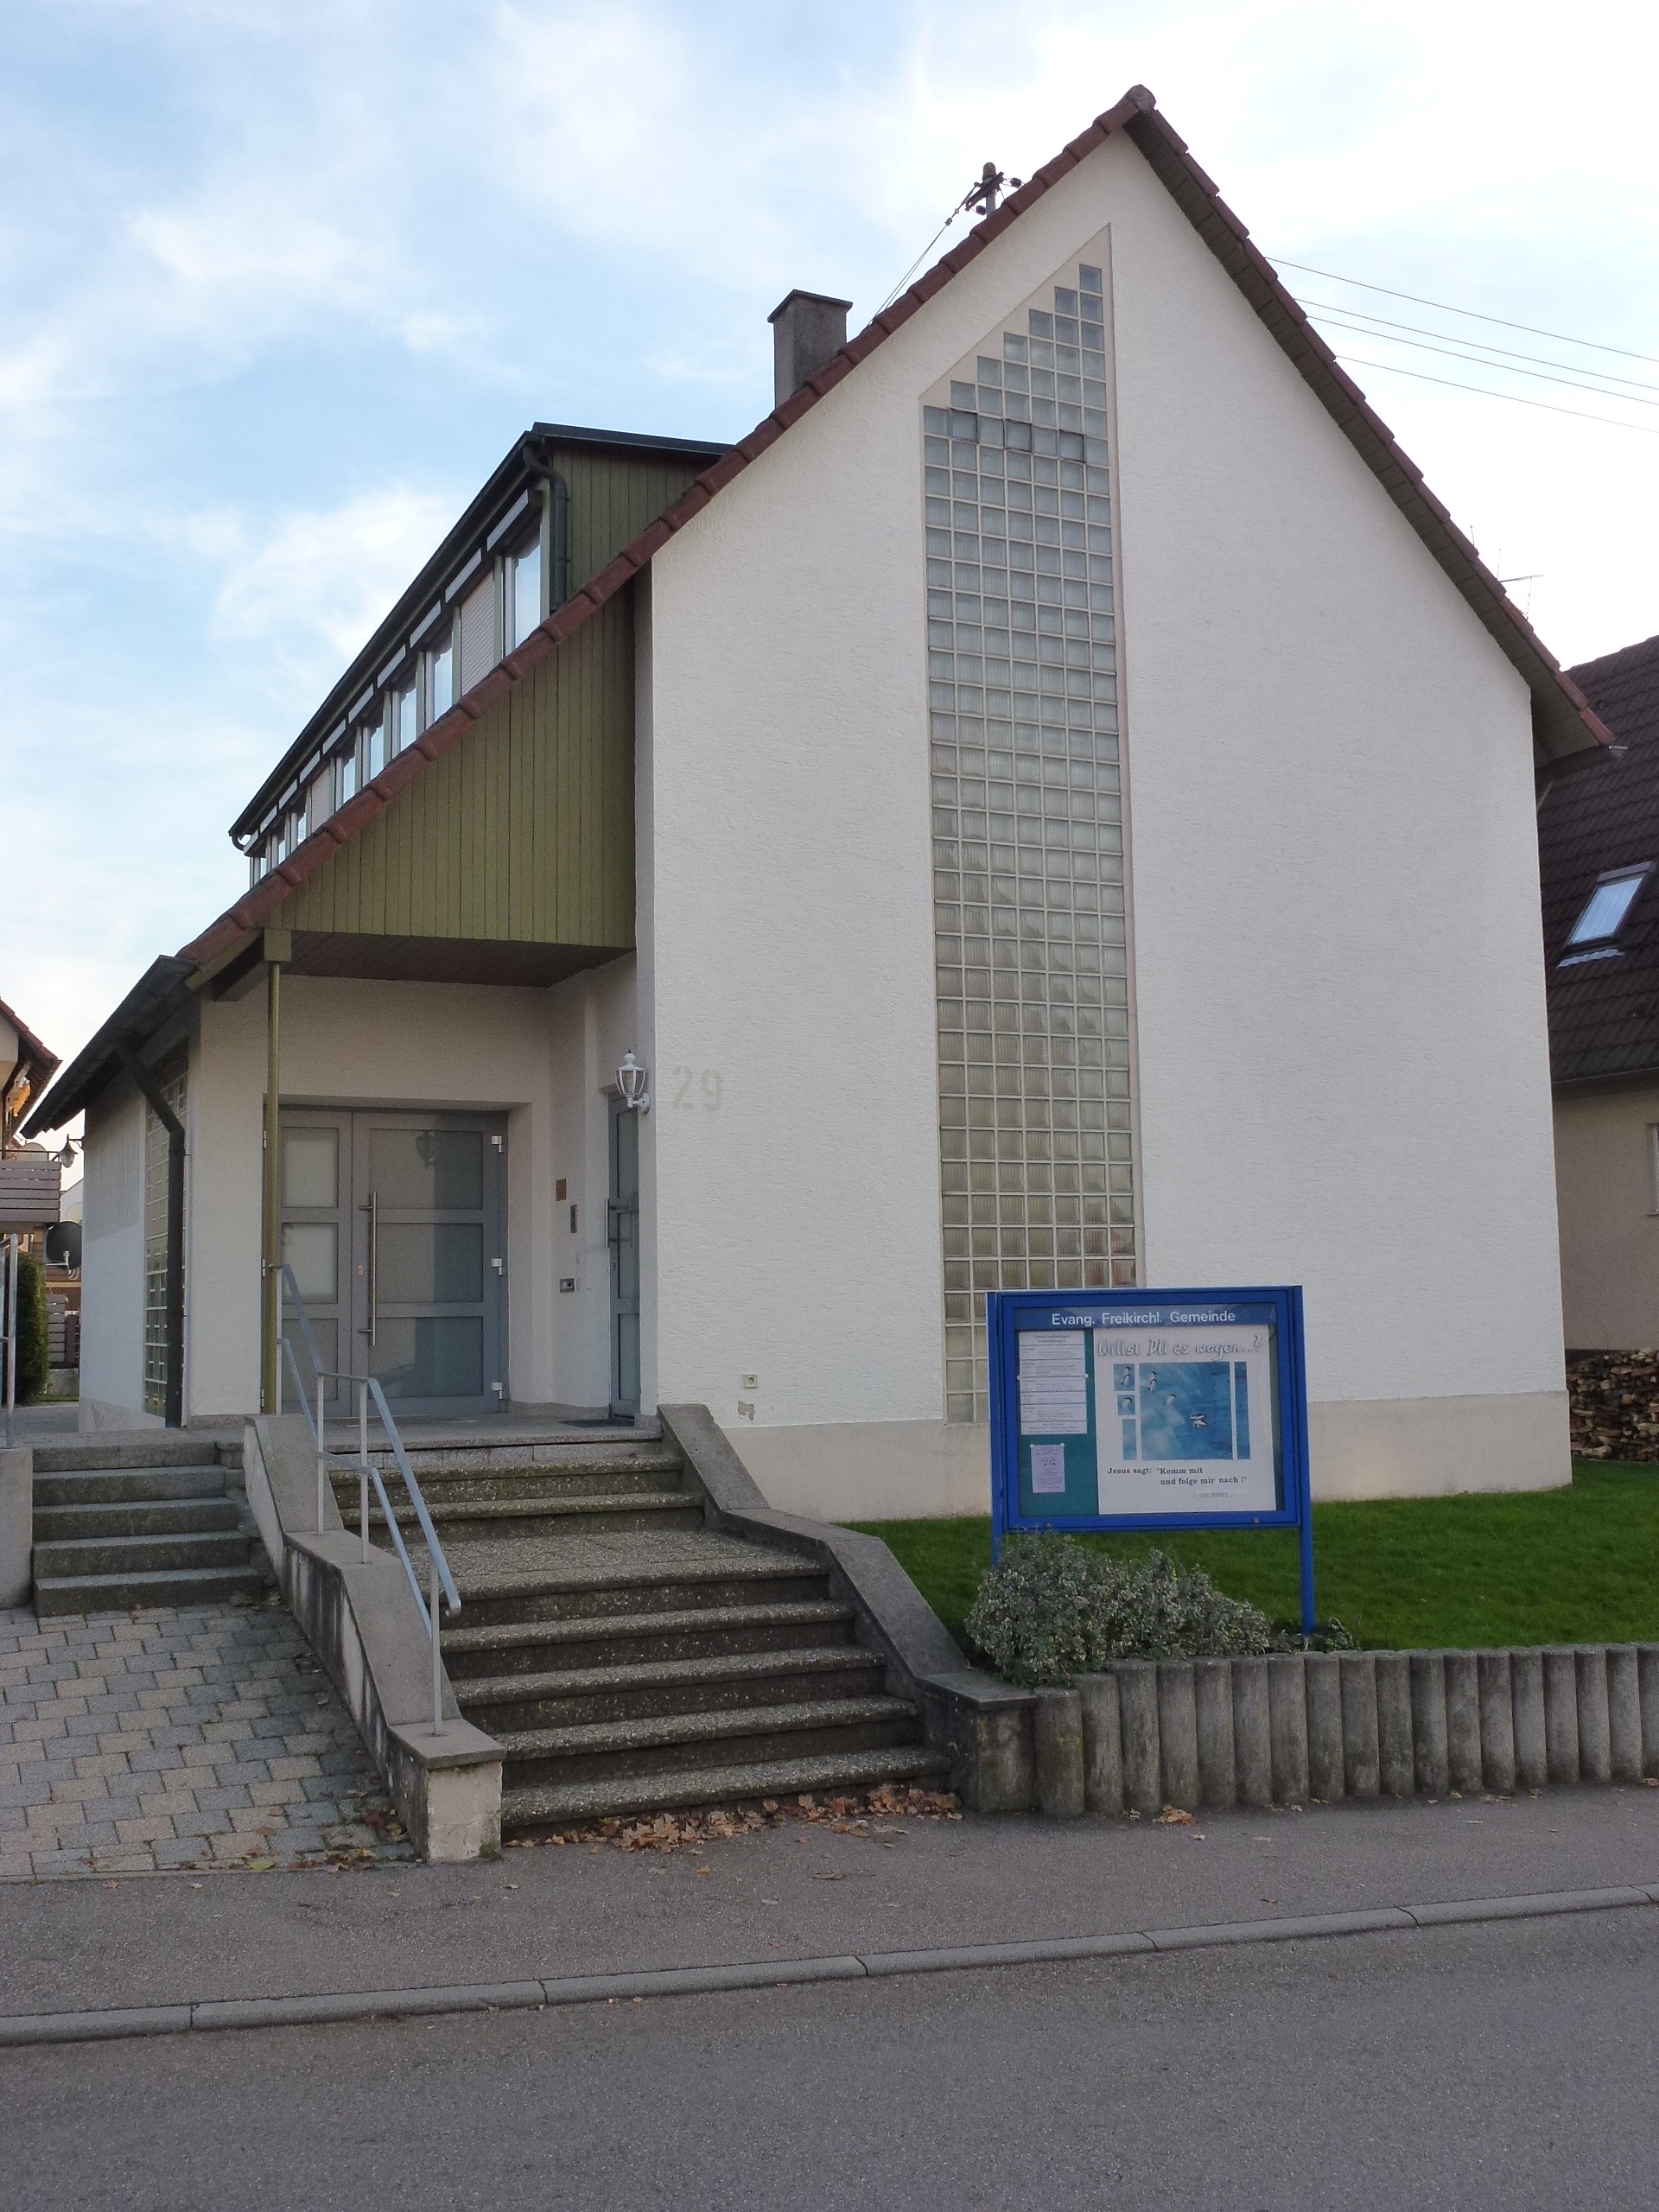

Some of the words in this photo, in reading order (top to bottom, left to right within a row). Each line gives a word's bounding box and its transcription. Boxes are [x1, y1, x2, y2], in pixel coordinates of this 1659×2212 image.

[673, 1065, 722, 1111] 29
[1052, 1313, 1095, 1326] Evang.
[1102, 1312, 1162, 1324] Freikirchl.
[1170, 1310, 1236, 1323] Gemeinde
[1097, 1338, 1141, 1356] Willst
[1173, 1343, 1189, 1354] es
[1179, 1478, 1198, 1486] folge
